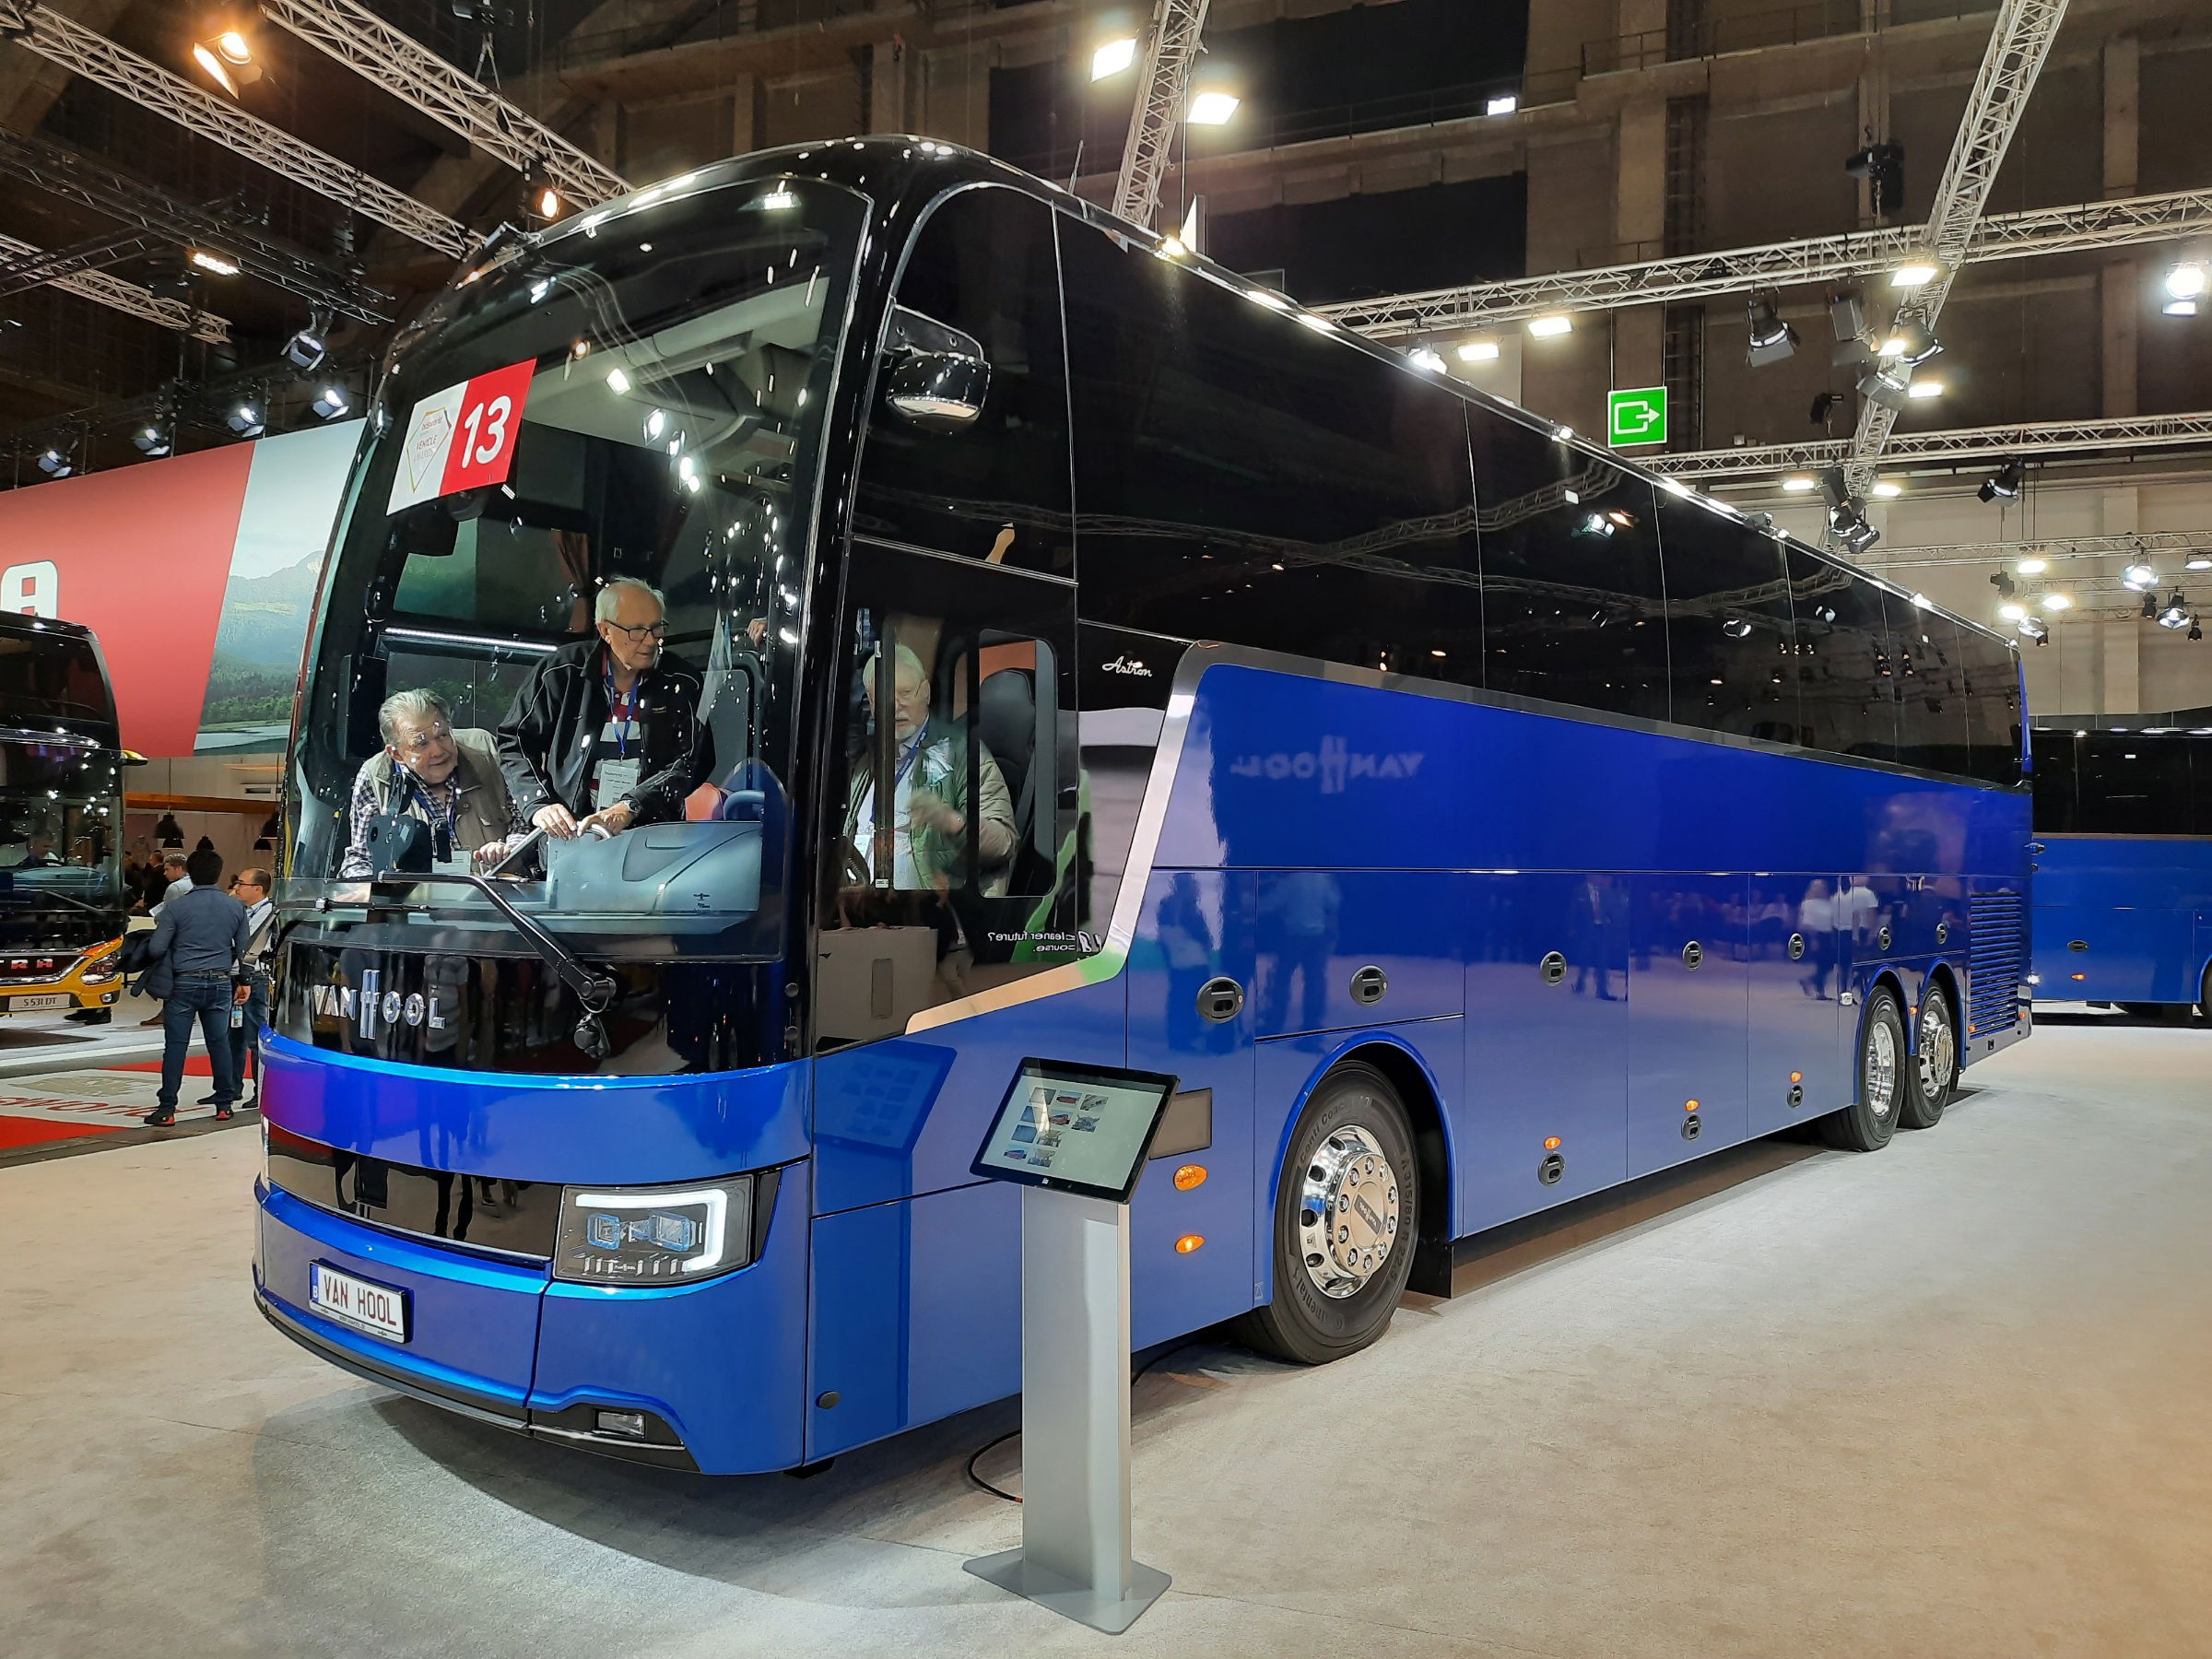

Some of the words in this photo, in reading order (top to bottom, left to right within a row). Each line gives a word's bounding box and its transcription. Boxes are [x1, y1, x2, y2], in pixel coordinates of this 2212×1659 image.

[462, 395, 512, 469] 13
[1101, 655, 1153, 677] Astron
[324, 1274, 348, 1309] VAN
[358, 1287, 397, 1326] HOOL
